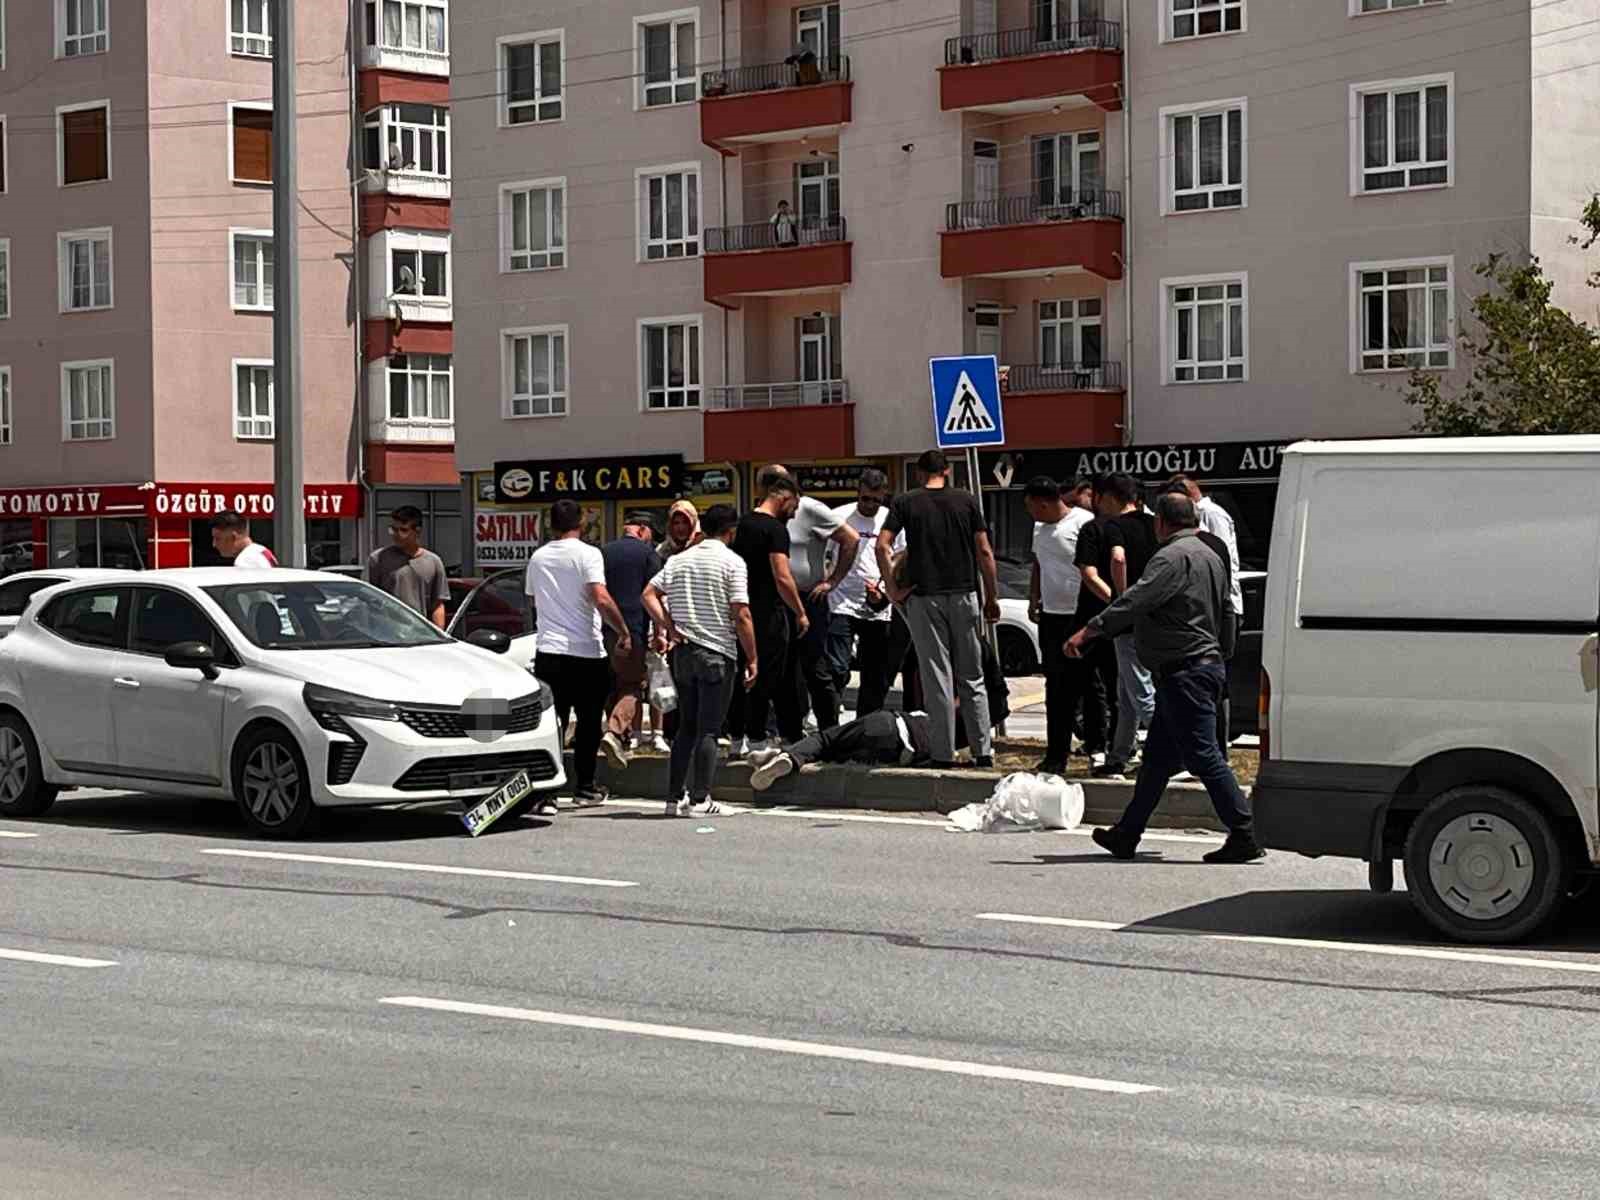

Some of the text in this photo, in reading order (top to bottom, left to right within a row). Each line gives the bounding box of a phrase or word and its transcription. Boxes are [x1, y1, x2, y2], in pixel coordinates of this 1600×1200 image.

[1239, 446, 1286, 470] AU
[539, 466, 671, 492] F&K CARS
[156, 488, 342, 513] ÖZGÜR OTOTİV
[476, 514, 538, 541] SATILIK
